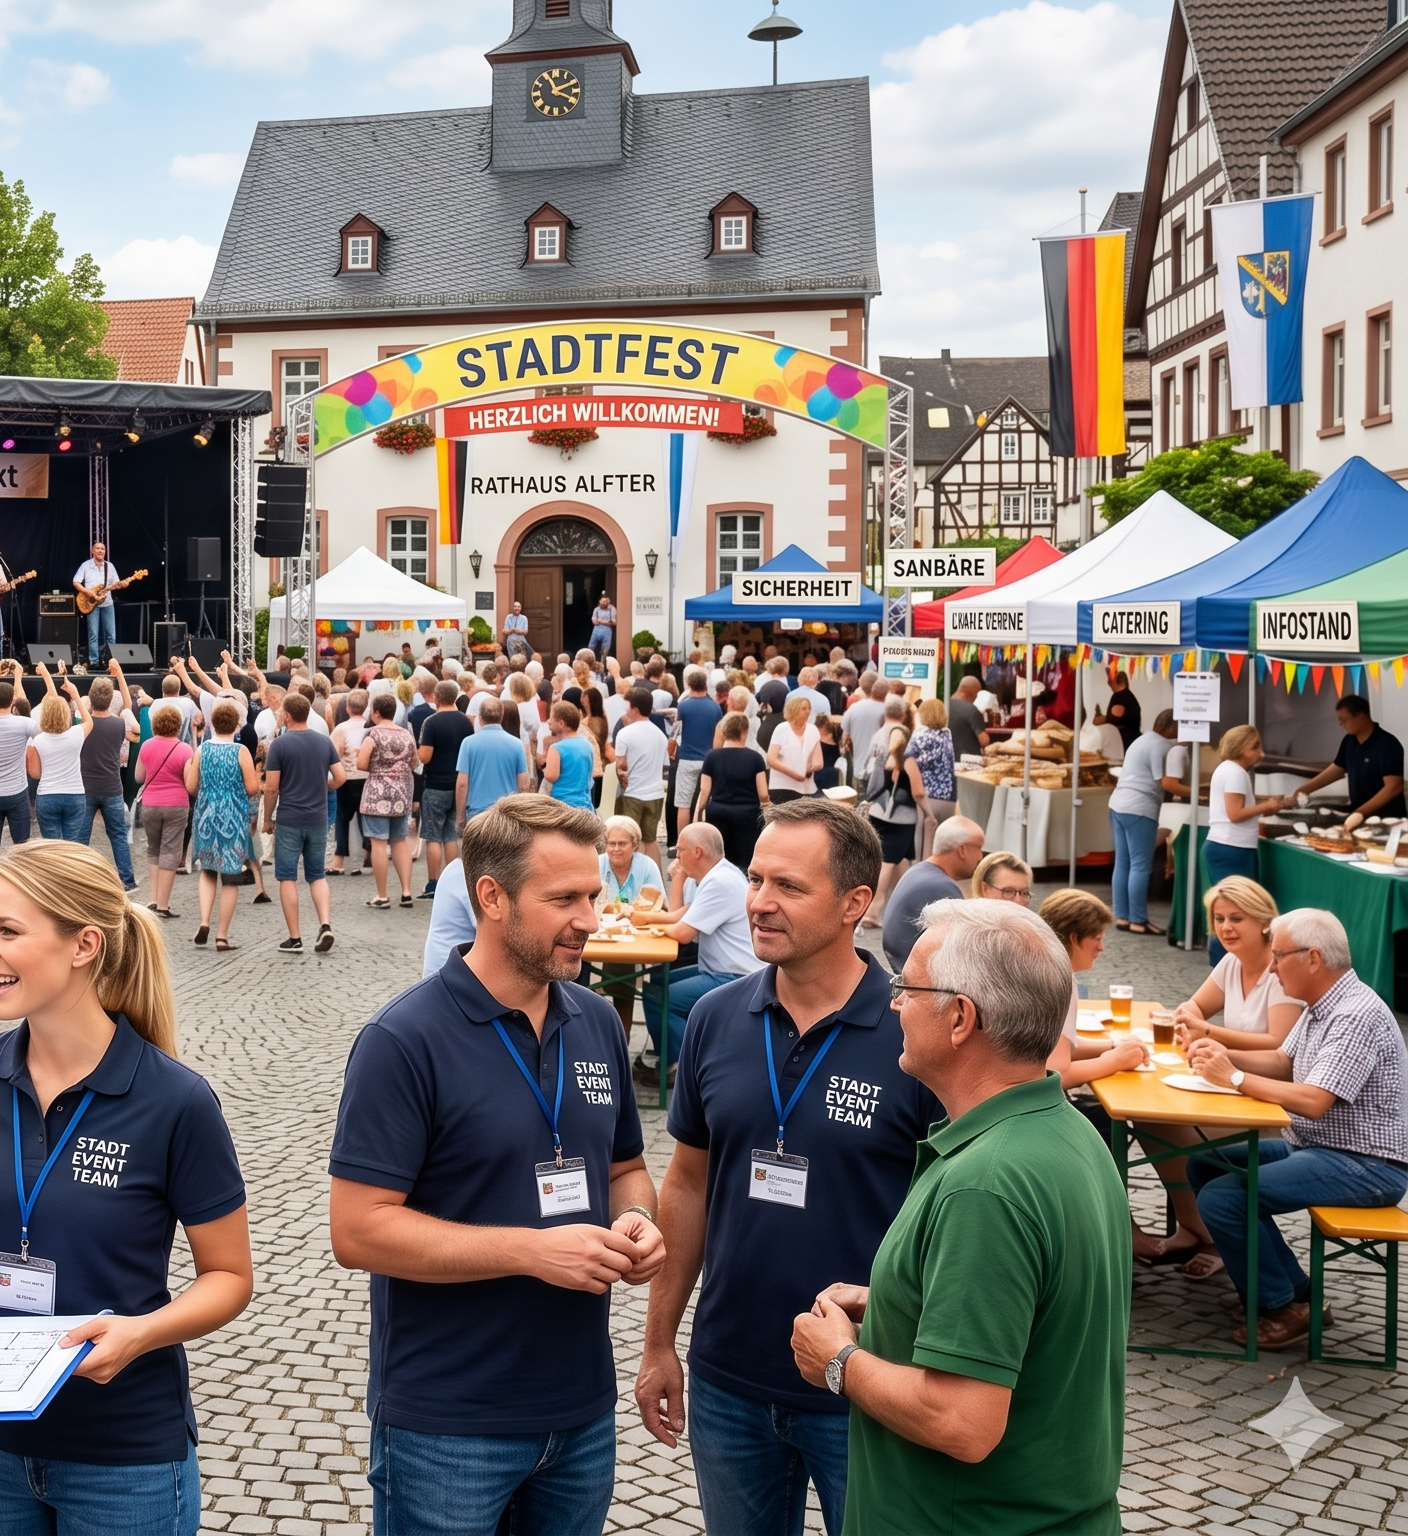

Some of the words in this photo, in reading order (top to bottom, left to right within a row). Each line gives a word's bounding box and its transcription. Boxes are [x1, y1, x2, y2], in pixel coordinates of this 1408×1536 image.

[456, 333, 739, 388] STADTFEST
[469, 403, 567, 430] HERZLICH
[572, 401, 720, 428] WILLKOMMEN!
[471, 475, 567, 495] RATHAUS
[574, 473, 656, 493] ALFTER
[894, 553, 985, 578] SANBÄRE
[742, 579, 853, 597] SICHERHEIT
[1102, 610, 1169, 635] CATERING
[1263, 612, 1352, 641] INFOSTAND
[574, 1061, 609, 1075] STADT
[576, 1075, 612, 1090] EVENT
[828, 1075, 883, 1098] STADT
[582, 1091, 613, 1105] TEAM
[825, 1089, 880, 1113] EVENT
[826, 1105, 872, 1129] TEAM
[76, 1136, 131, 1156] STADT
[71, 1151, 128, 1172] EVENT
[72, 1167, 119, 1189] TEAM
